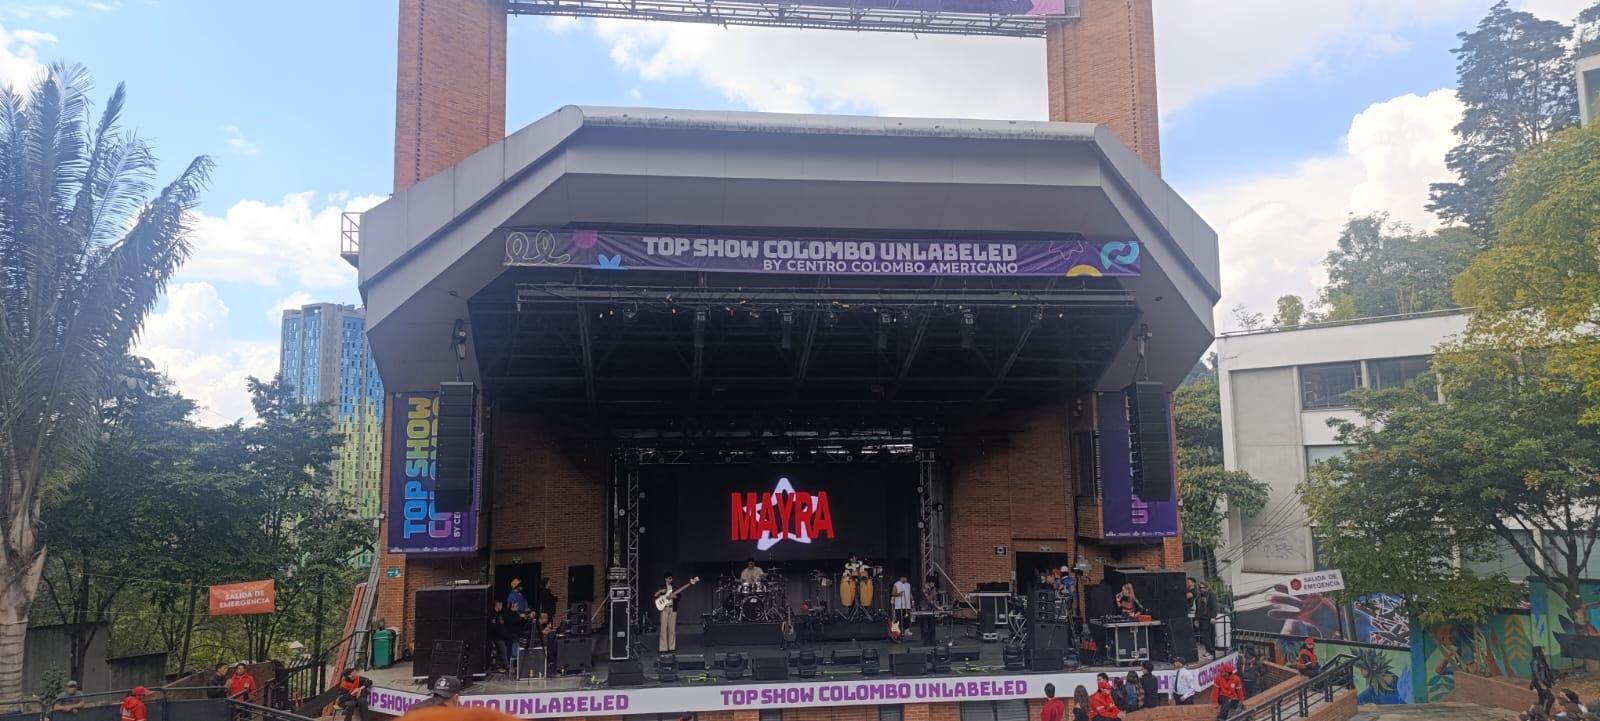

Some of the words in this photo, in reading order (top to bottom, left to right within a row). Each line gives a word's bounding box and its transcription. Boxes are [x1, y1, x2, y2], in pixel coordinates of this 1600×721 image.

[643, 236, 690, 256] TOP
[693, 238, 759, 258] SHOW
[763, 240, 876, 260] COLOMBO
[880, 242, 1017, 261] UNLABELED
[763, 259, 782, 271] BY
[787, 260, 847, 272] CENTRO
[851, 261, 925, 273] COLOMBO
[929, 262, 1018, 274] AMERICANO
[406, 397, 432, 478] SHOW
[404, 480, 428, 539] TOP
[731, 491, 835, 541] MAYRA
[1304, 575, 1326, 583] SALIDA
[219, 597, 271, 608] EMERGENCIA
[225, 590, 252, 600] SALIDA
[720, 689, 758, 705] TOP
[761, 687, 815, 704] SHOW
[819, 682, 911, 701] COLOMBO
[915, 680, 1028, 699] UNLABELED
[505, 694, 629, 715] UNLABELED
